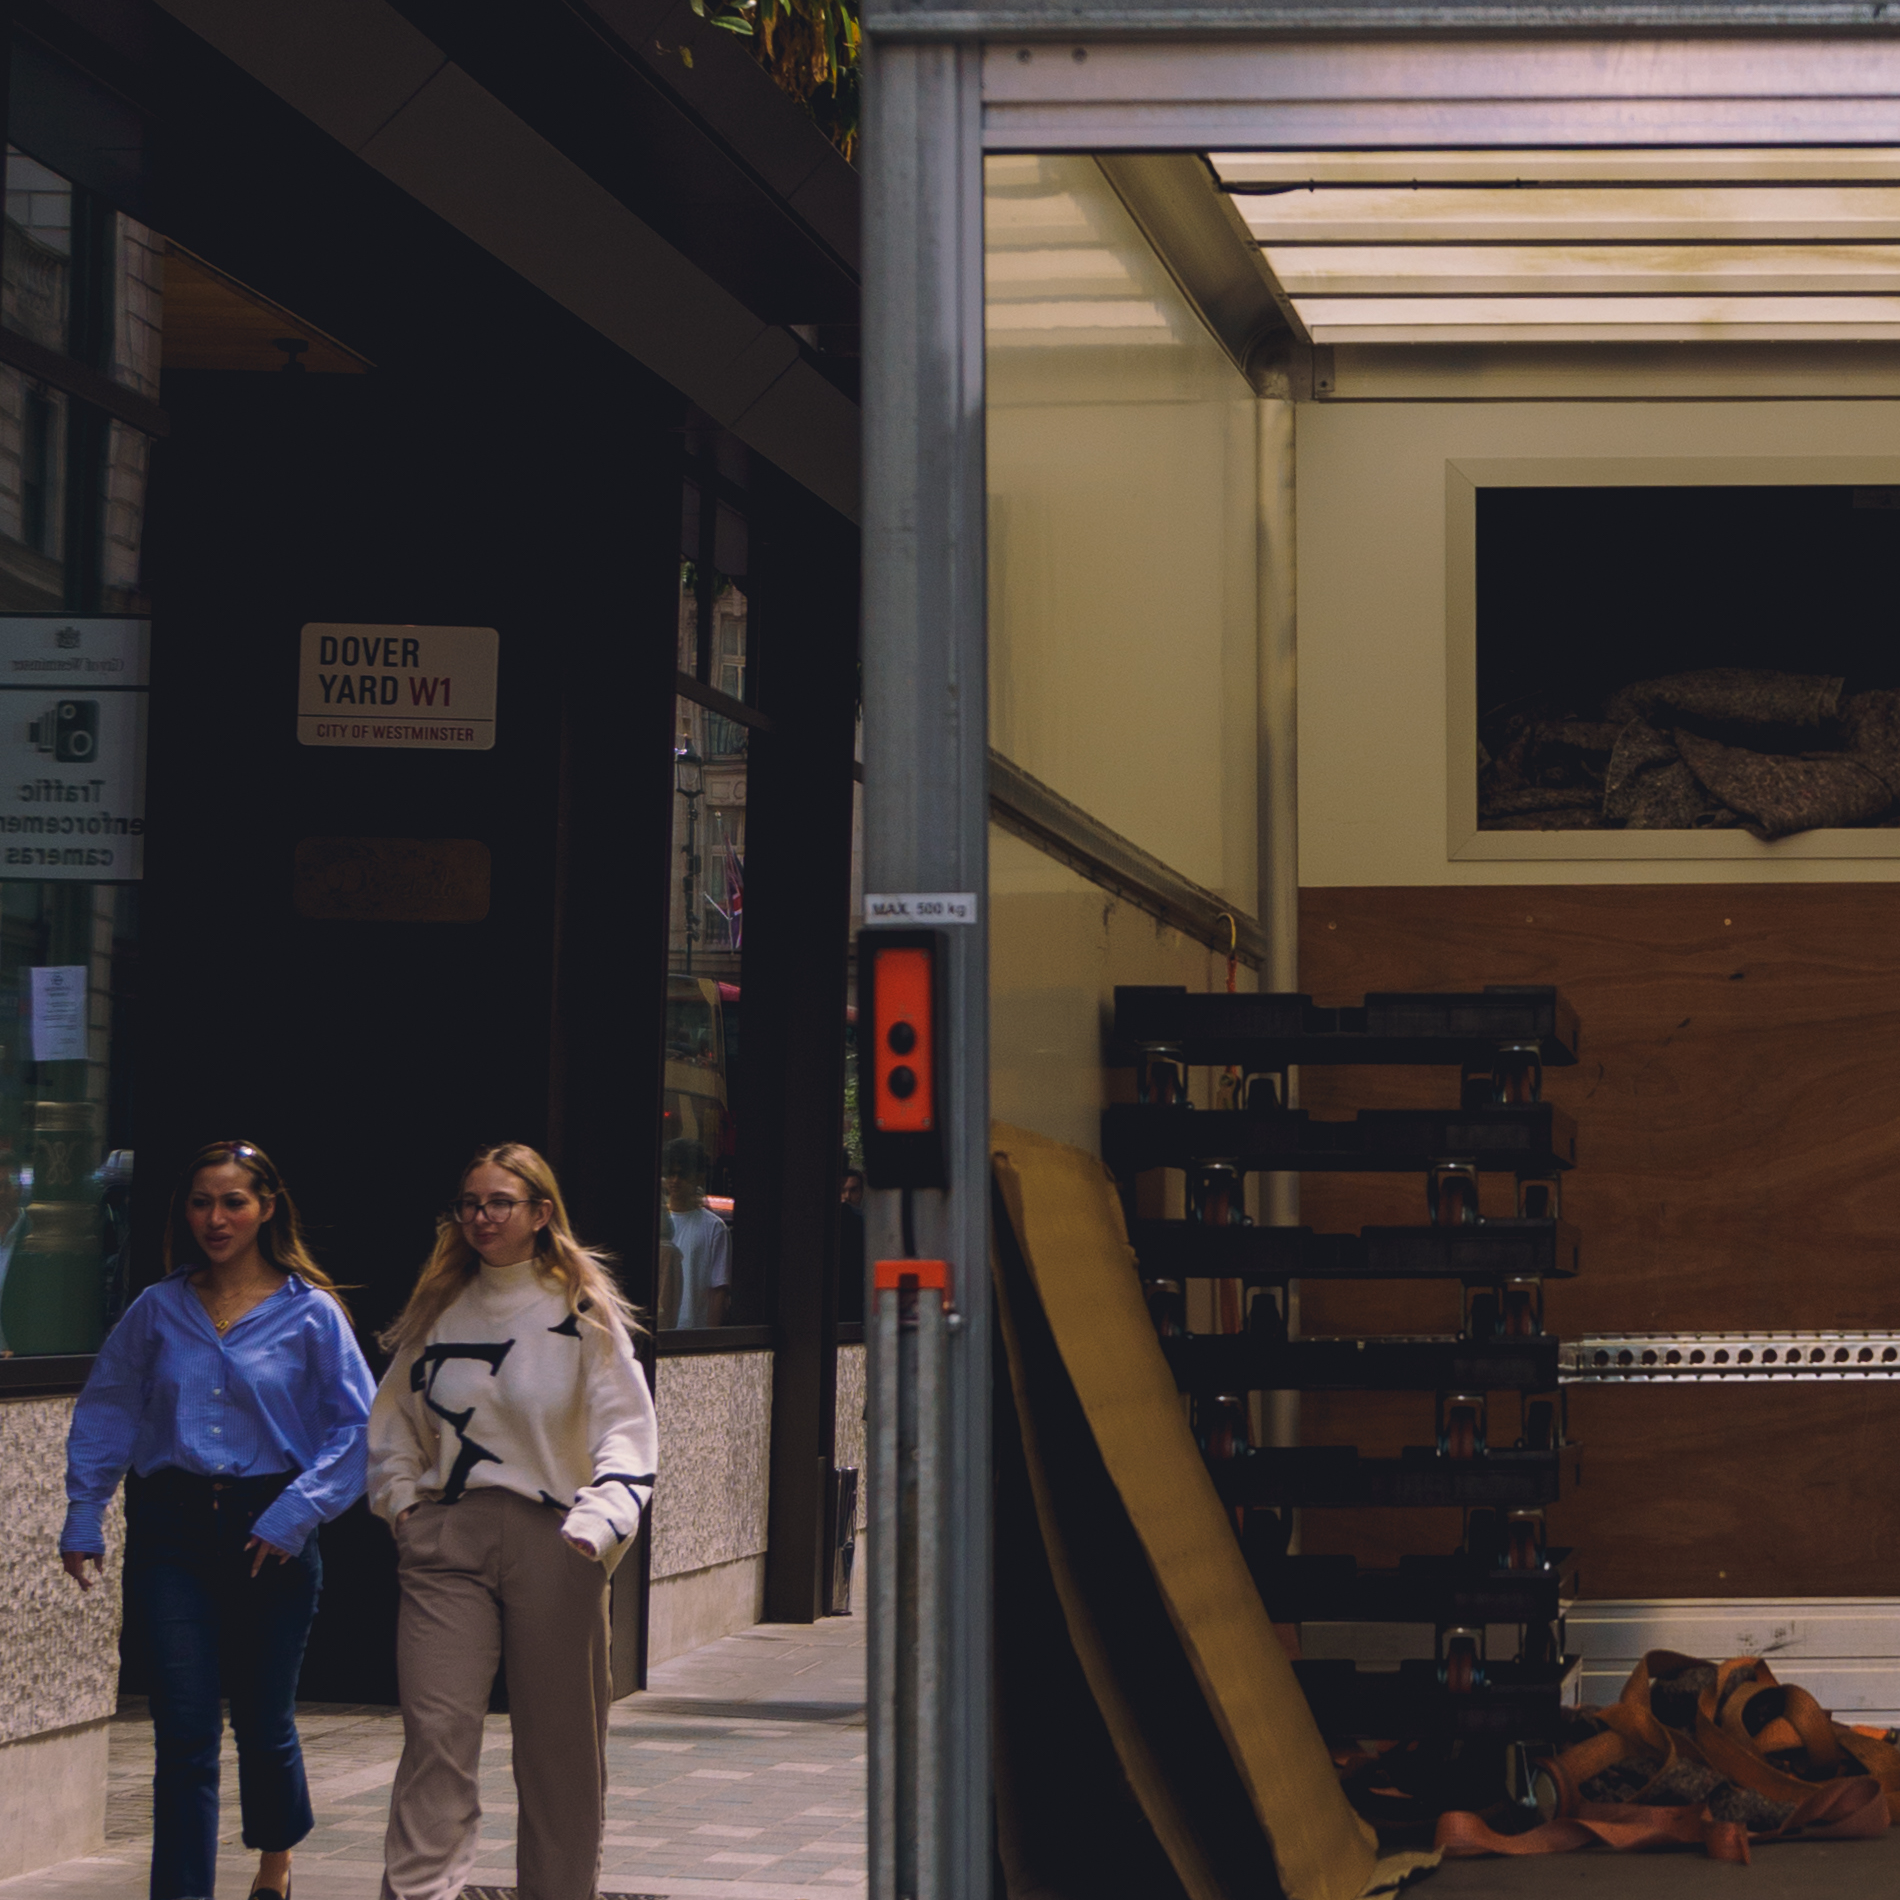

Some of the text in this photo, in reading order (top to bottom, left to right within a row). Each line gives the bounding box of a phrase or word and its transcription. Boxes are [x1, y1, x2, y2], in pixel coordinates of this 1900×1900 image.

[320, 636, 420, 668] DOVER
[319, 674, 450, 707] YARD W1
[317, 724, 474, 742] CITY OF WESTMINSTER
[916, 902, 943, 915] 500
[947, 902, 967, 917] kg
